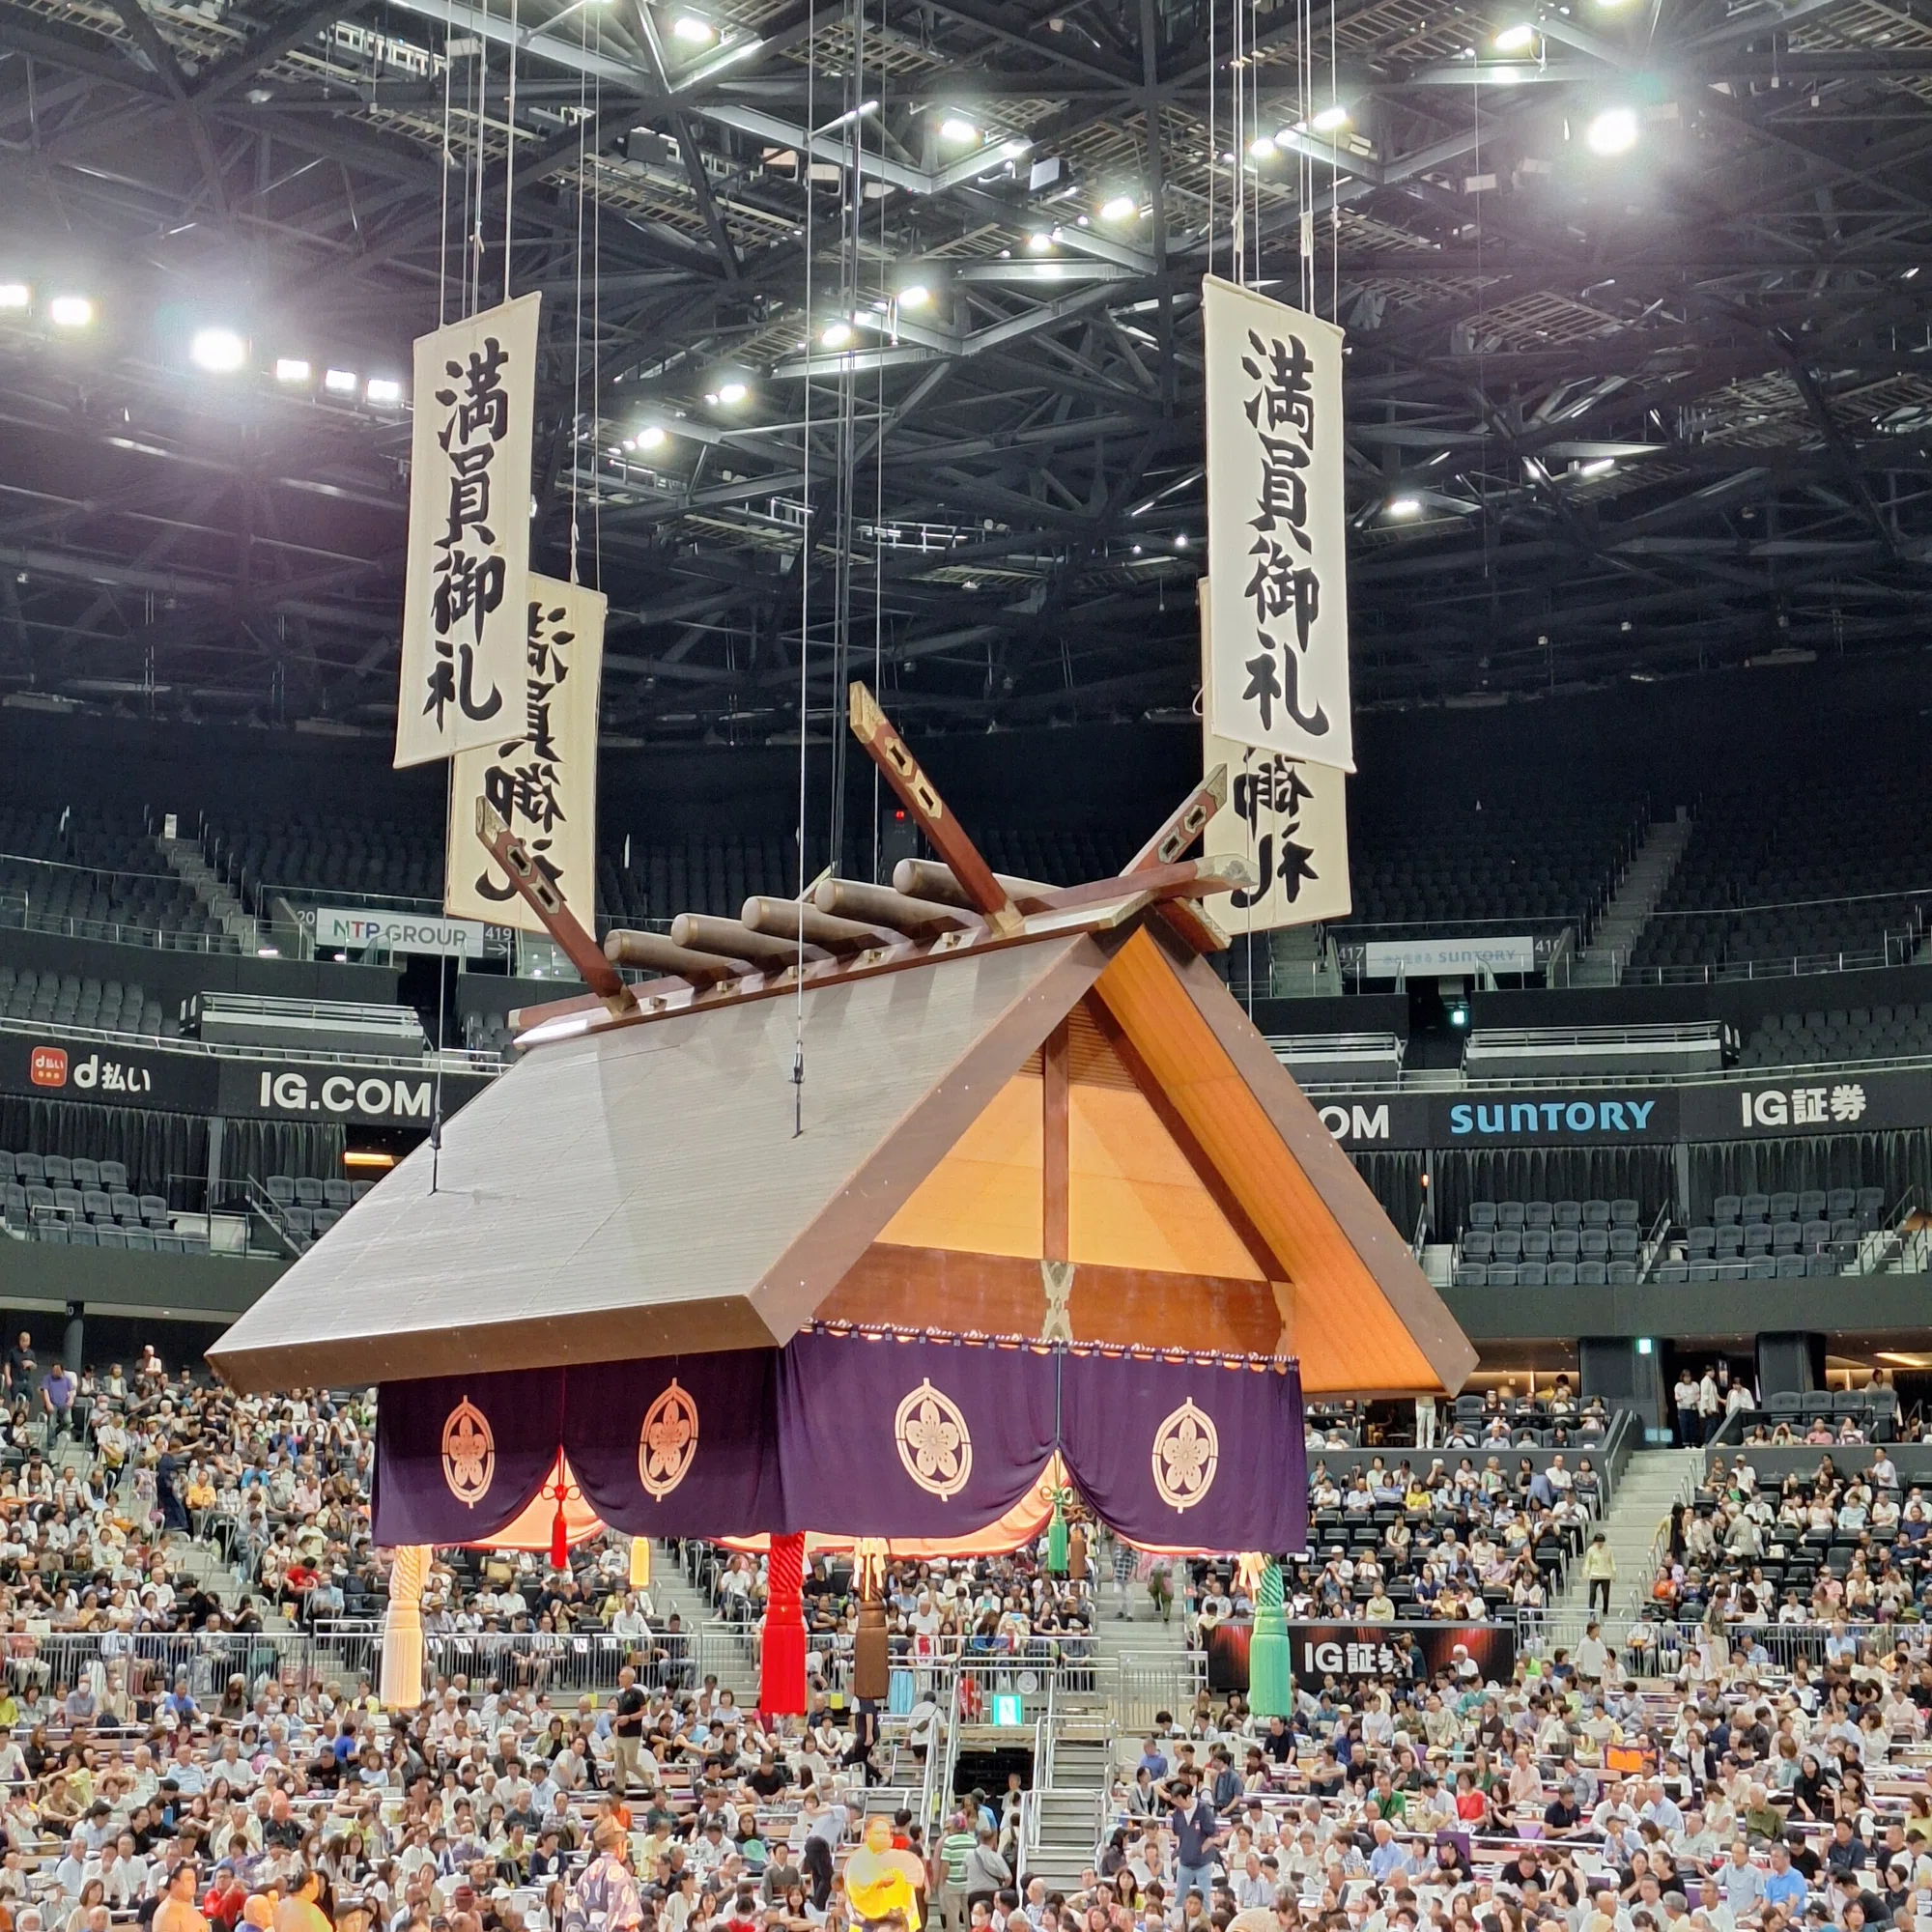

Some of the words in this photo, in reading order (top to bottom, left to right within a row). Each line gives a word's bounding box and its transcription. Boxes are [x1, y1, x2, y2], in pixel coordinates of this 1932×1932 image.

[422, 337, 509, 734] 満員御礼
[1242, 330, 1329, 736] 満員御礼
[297, 910, 316, 924] 20
[333, 919, 381, 940] NTP
[386, 923, 468, 947] GROUP
[485, 925, 513, 941] 419
[1339, 947, 1365, 960] 417
[73, 1054, 151, 1093] d払い
[260, 1071, 432, 1118] IG.COM
[1741, 1084, 1866, 1127] IG証券
